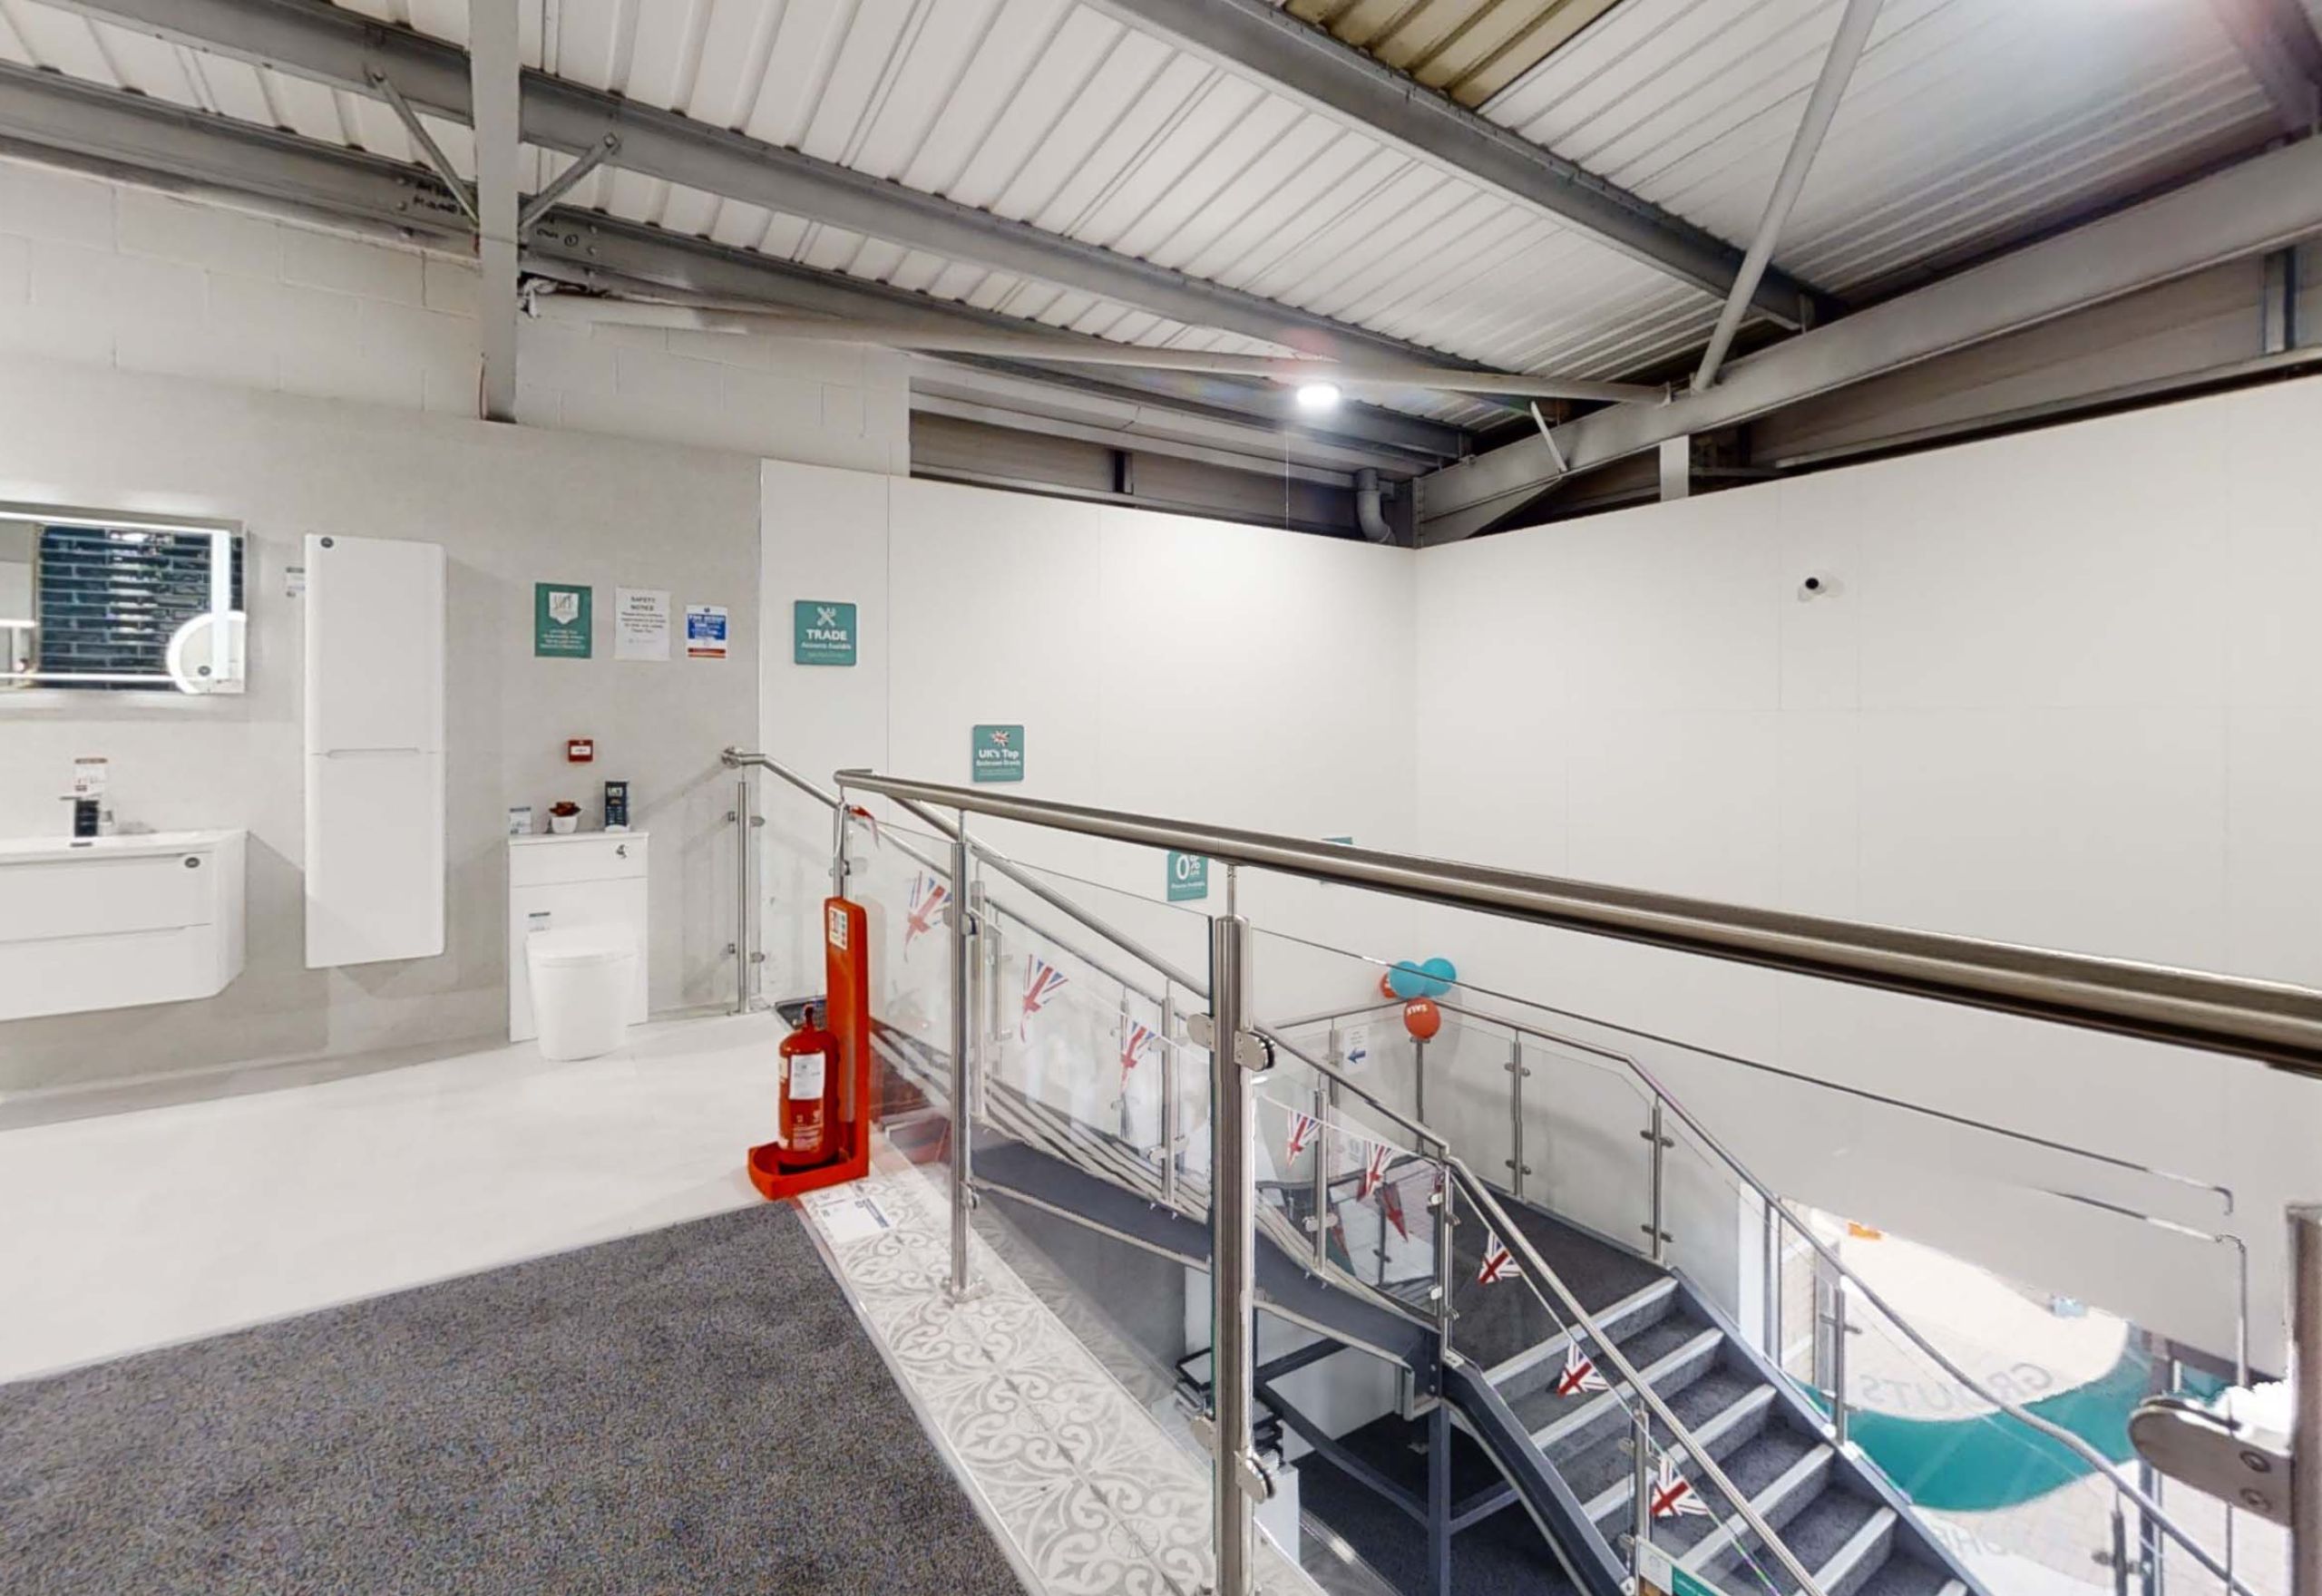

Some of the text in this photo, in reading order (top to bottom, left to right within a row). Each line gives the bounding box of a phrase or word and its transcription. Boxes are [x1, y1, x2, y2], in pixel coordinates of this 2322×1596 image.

[805, 628, 846, 640] TRADE
[979, 749, 1019, 760] UK's Top
